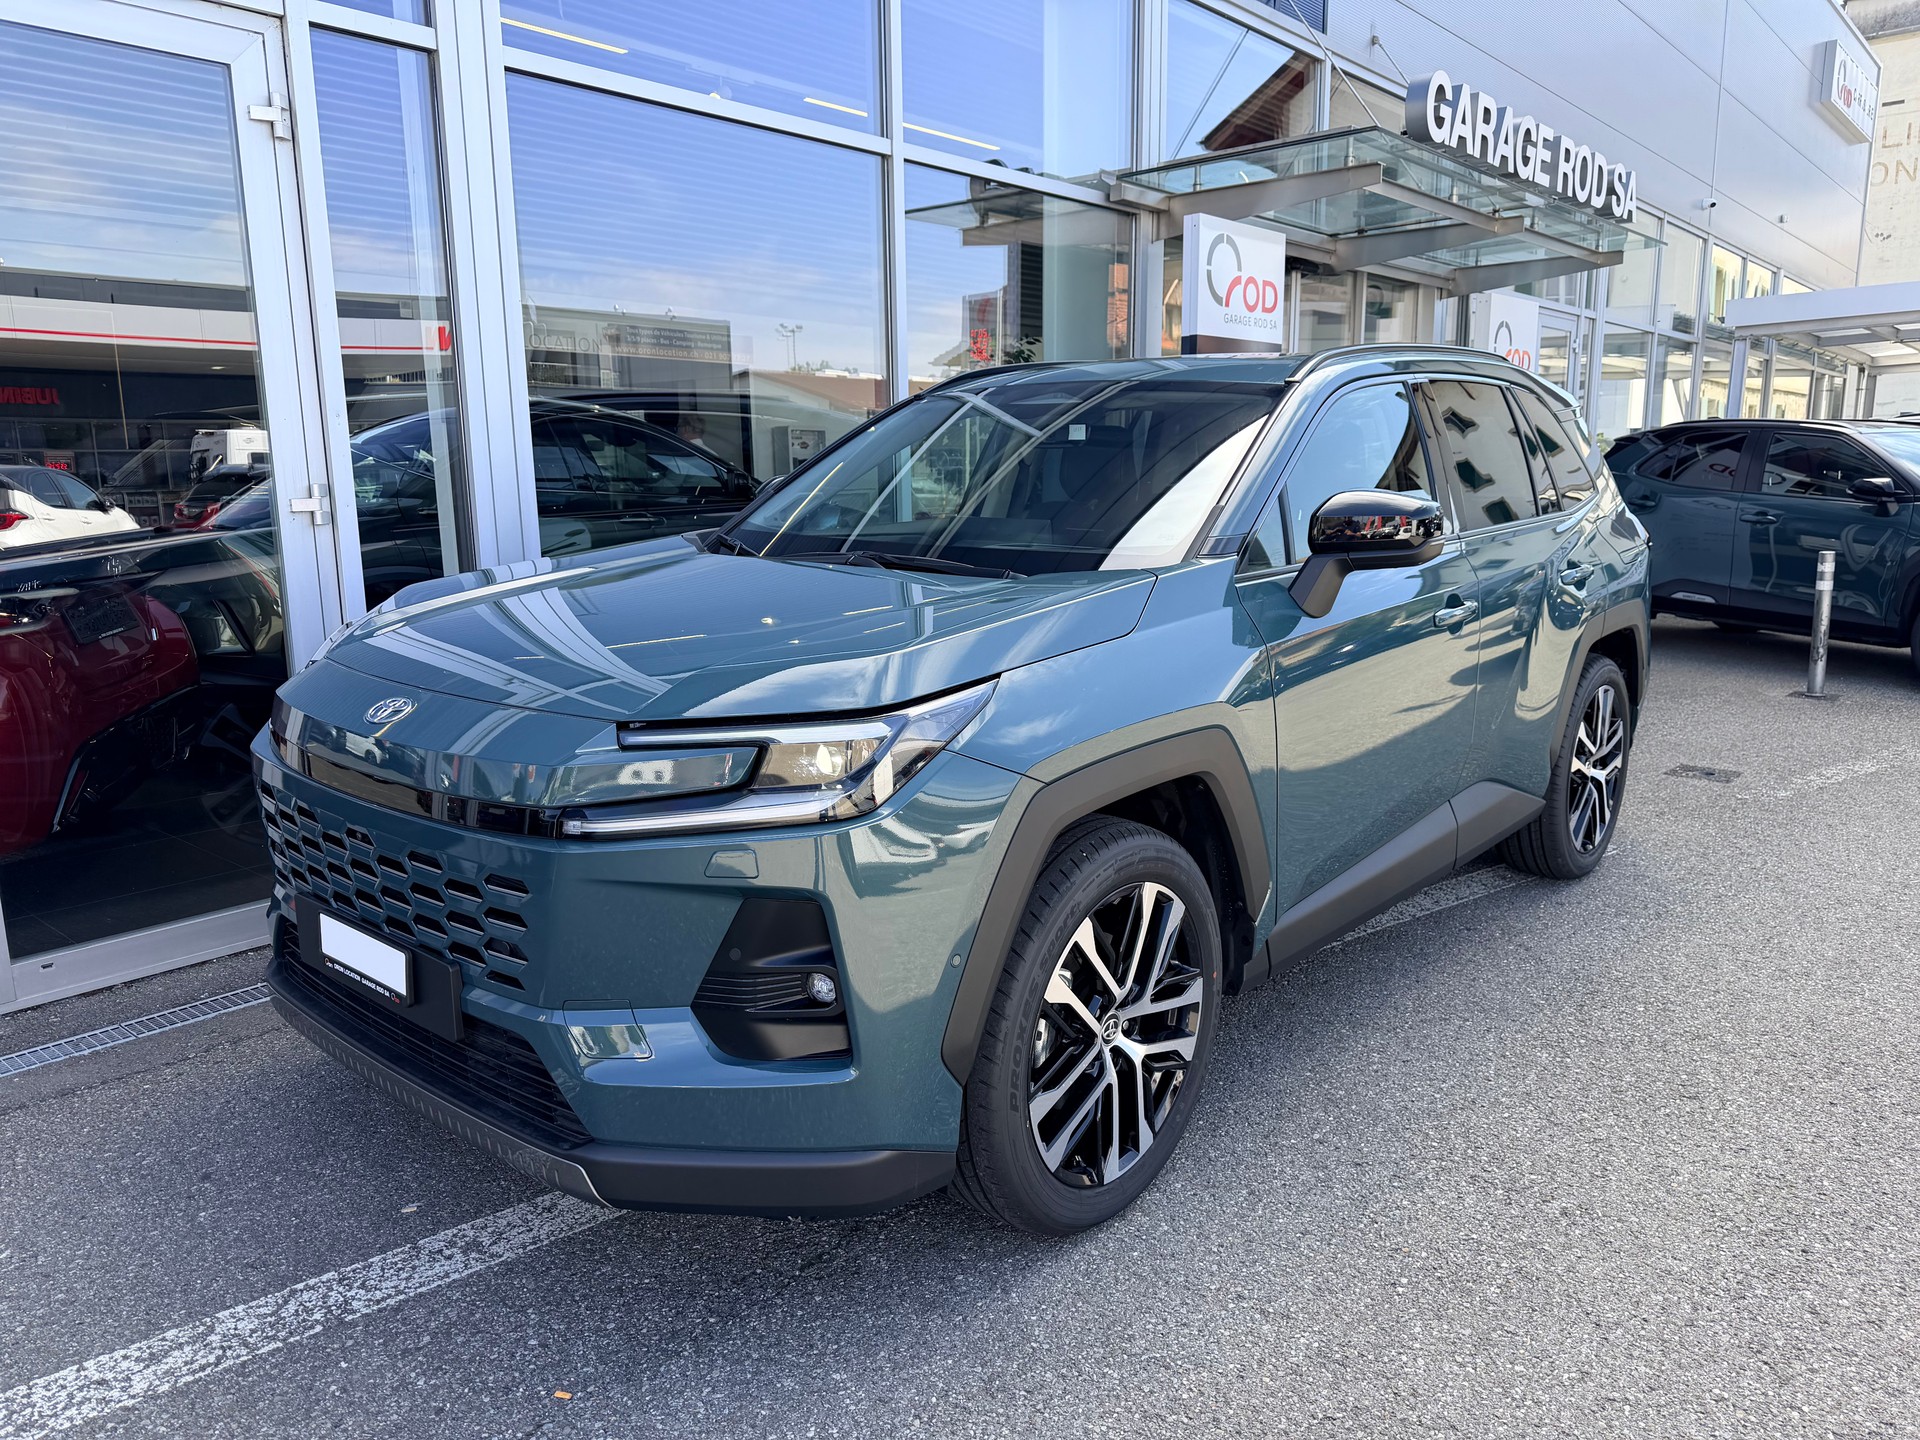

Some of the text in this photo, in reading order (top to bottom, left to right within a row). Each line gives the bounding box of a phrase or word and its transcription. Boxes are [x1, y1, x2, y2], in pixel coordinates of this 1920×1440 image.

[1881, 121, 1920, 149] LI
[1426, 70, 1637, 224] GARAGE ROD SA
[1223, 312, 1278, 331] GARAGE ROD SA
[525, 333, 603, 352] OCATION
[615, 346, 699, 359] www.oronlocation.ch
[1009, 974, 1040, 1114] PROXES
